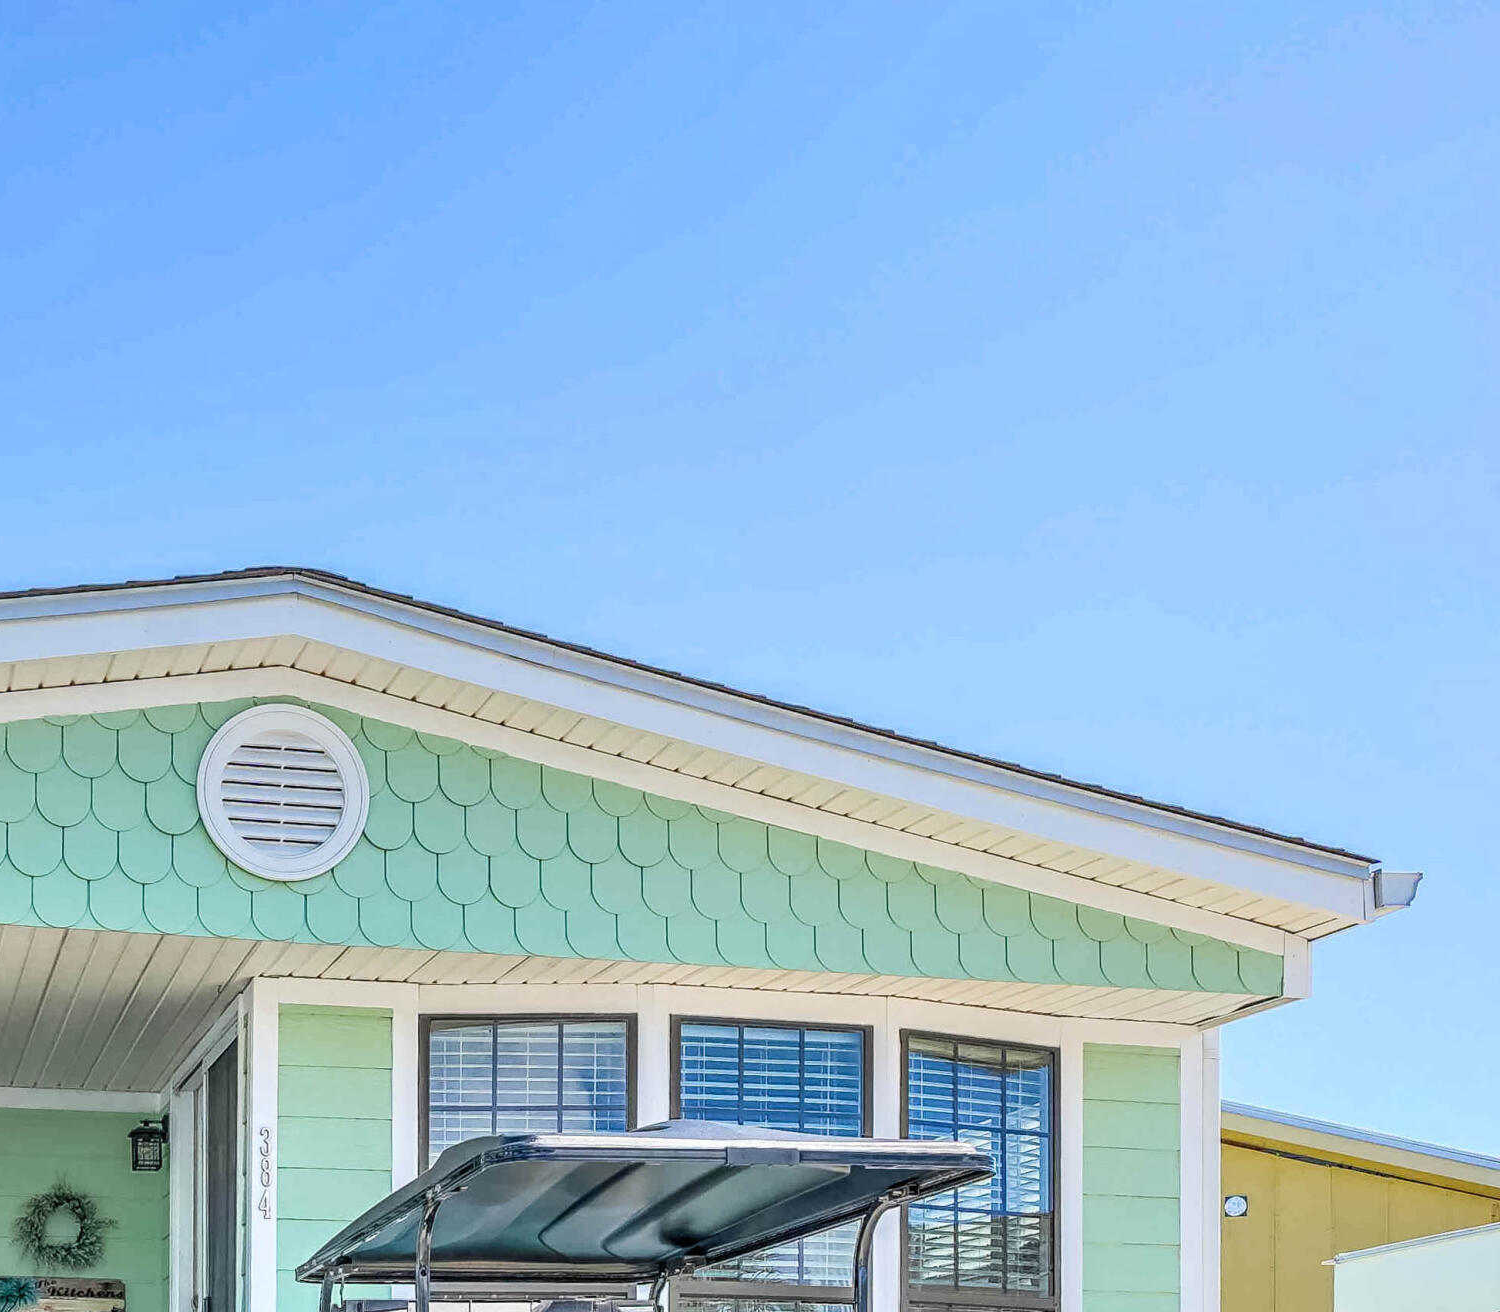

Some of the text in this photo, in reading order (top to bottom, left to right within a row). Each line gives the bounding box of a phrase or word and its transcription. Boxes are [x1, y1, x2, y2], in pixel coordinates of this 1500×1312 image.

[258, 1127, 271, 1220] 384
[35, 1279, 57, 1289] The
[47, 1287, 124, 1298] Kitchens
